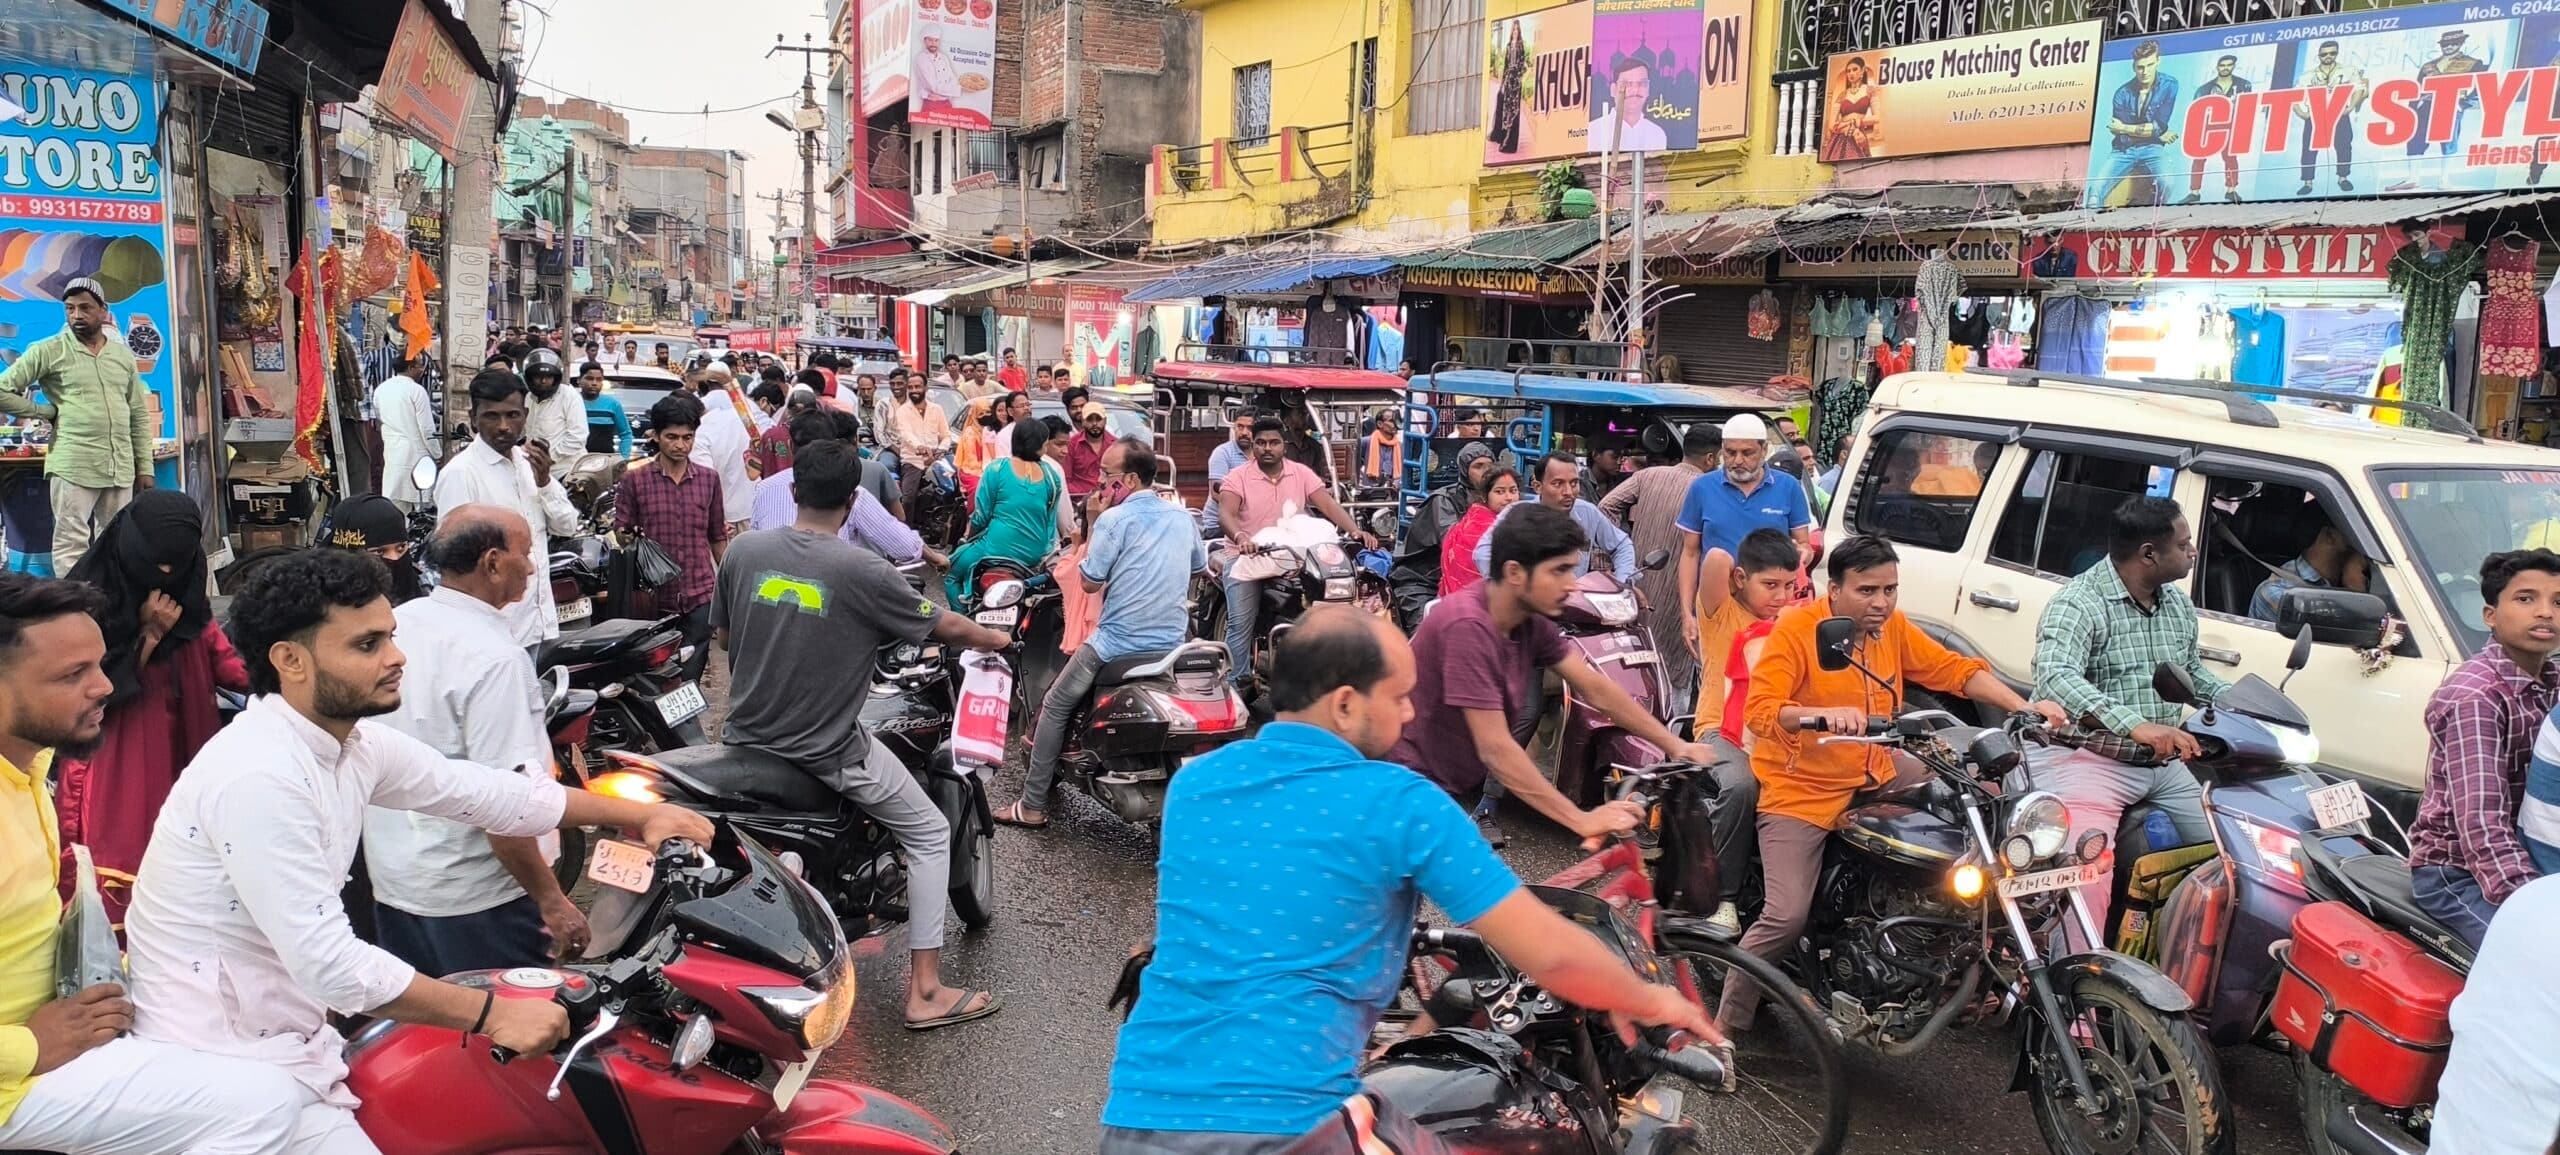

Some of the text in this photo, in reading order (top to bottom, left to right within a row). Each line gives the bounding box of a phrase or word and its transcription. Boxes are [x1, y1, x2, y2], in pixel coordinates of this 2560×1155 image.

[2463, 5, 2504, 21] Mob.
[2223, 33, 2246, 48] GST
[2248, 32, 2265, 46] IN
[1878, 37, 2090, 86] Blouse Matching Center
[1947, 86, 1974, 101] Deals
[1976, 86, 1987, 97] In
[1989, 81, 2022, 97] Bridal
[1949, 99, 2087, 124] Mob. 6201231618
[2181, 86, 2353, 159] CITY
[2466, 143, 2534, 167] Mens
[29, 199, 152, 220] 9931573789
[2087, 234, 2378, 274] CITY STYLE
[1406, 266, 1451, 287] KHUSHI
[1456, 270, 1537, 293] COLLECTION
[1071, 300, 1137, 313] MODI TAILORS
[665, 688, 695, 709] JH11A
[668, 698, 701, 719] S7129
